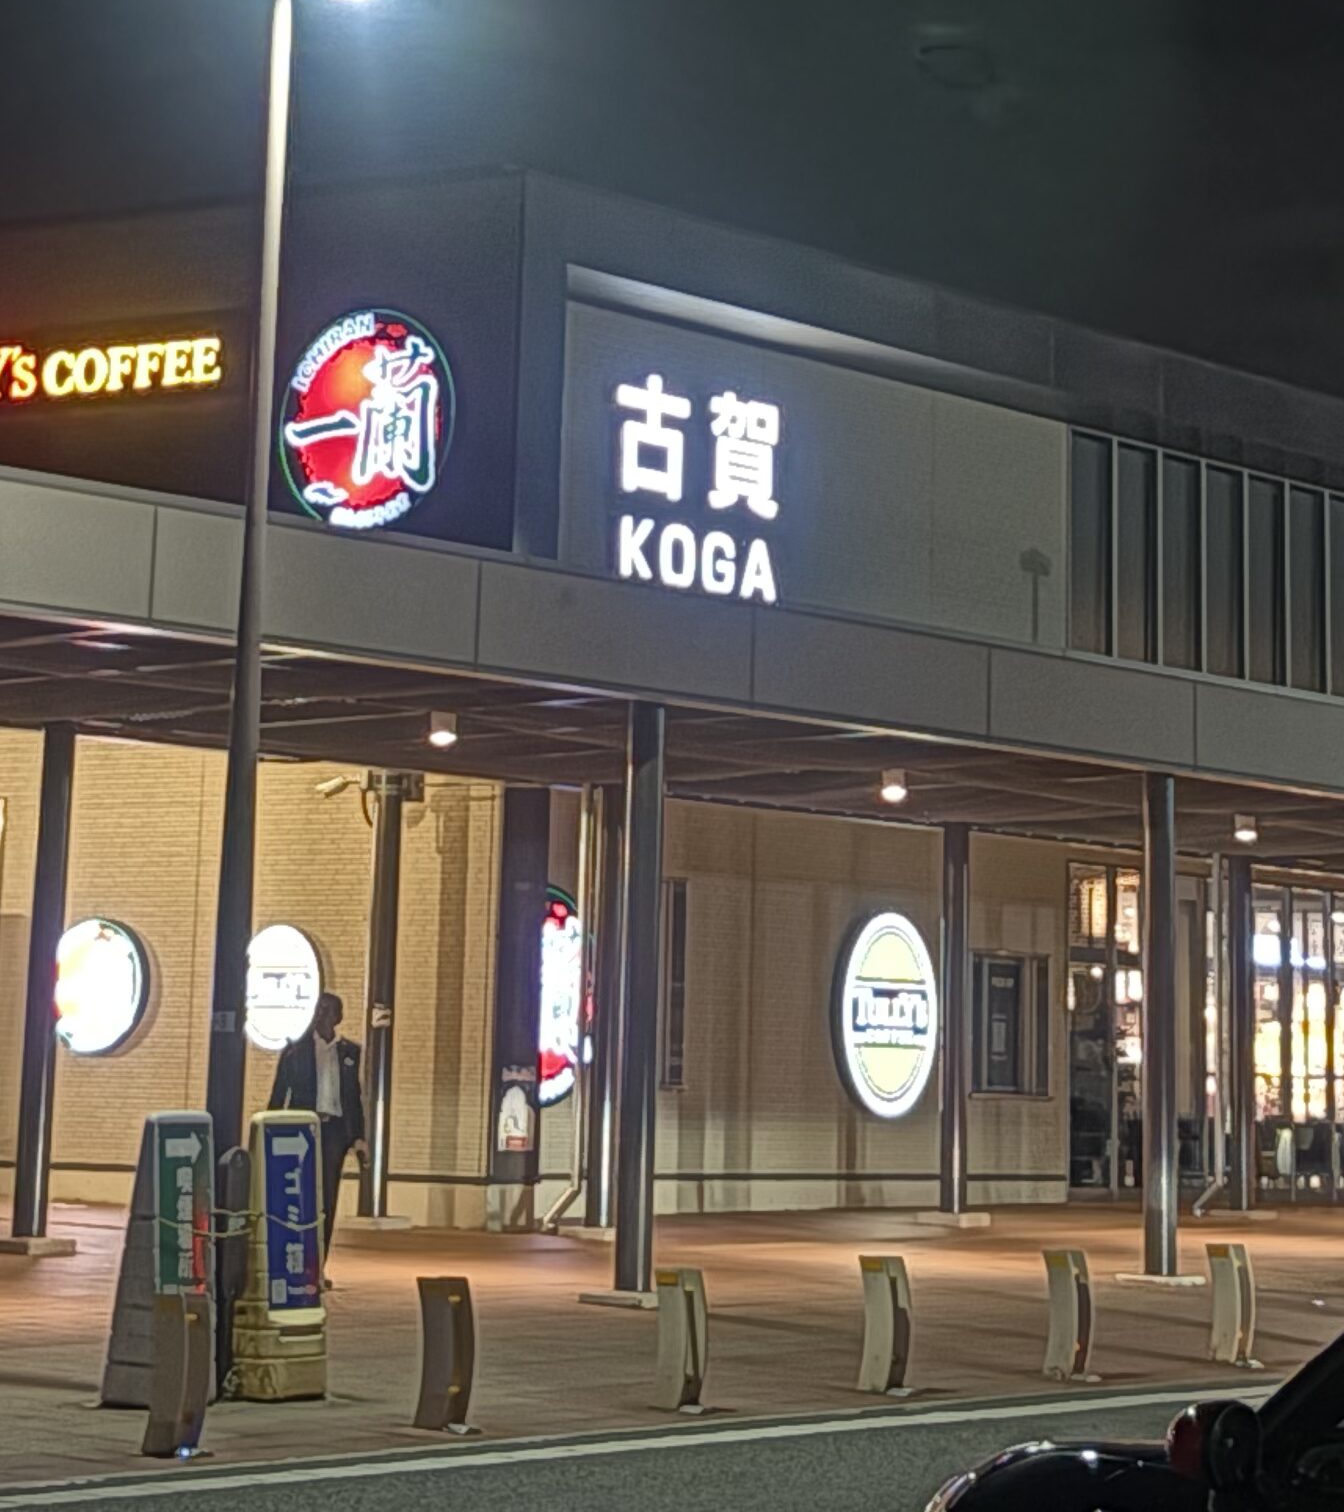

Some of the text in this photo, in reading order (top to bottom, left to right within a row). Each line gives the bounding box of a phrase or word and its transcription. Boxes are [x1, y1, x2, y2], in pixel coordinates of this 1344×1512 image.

[43, 338, 222, 397] COFFEE
[291, 312, 376, 392] ICHIRAN
[284, 335, 439, 492] 一蘭
[616, 374, 780, 520] 古賀
[619, 514, 777, 603] KOGA
